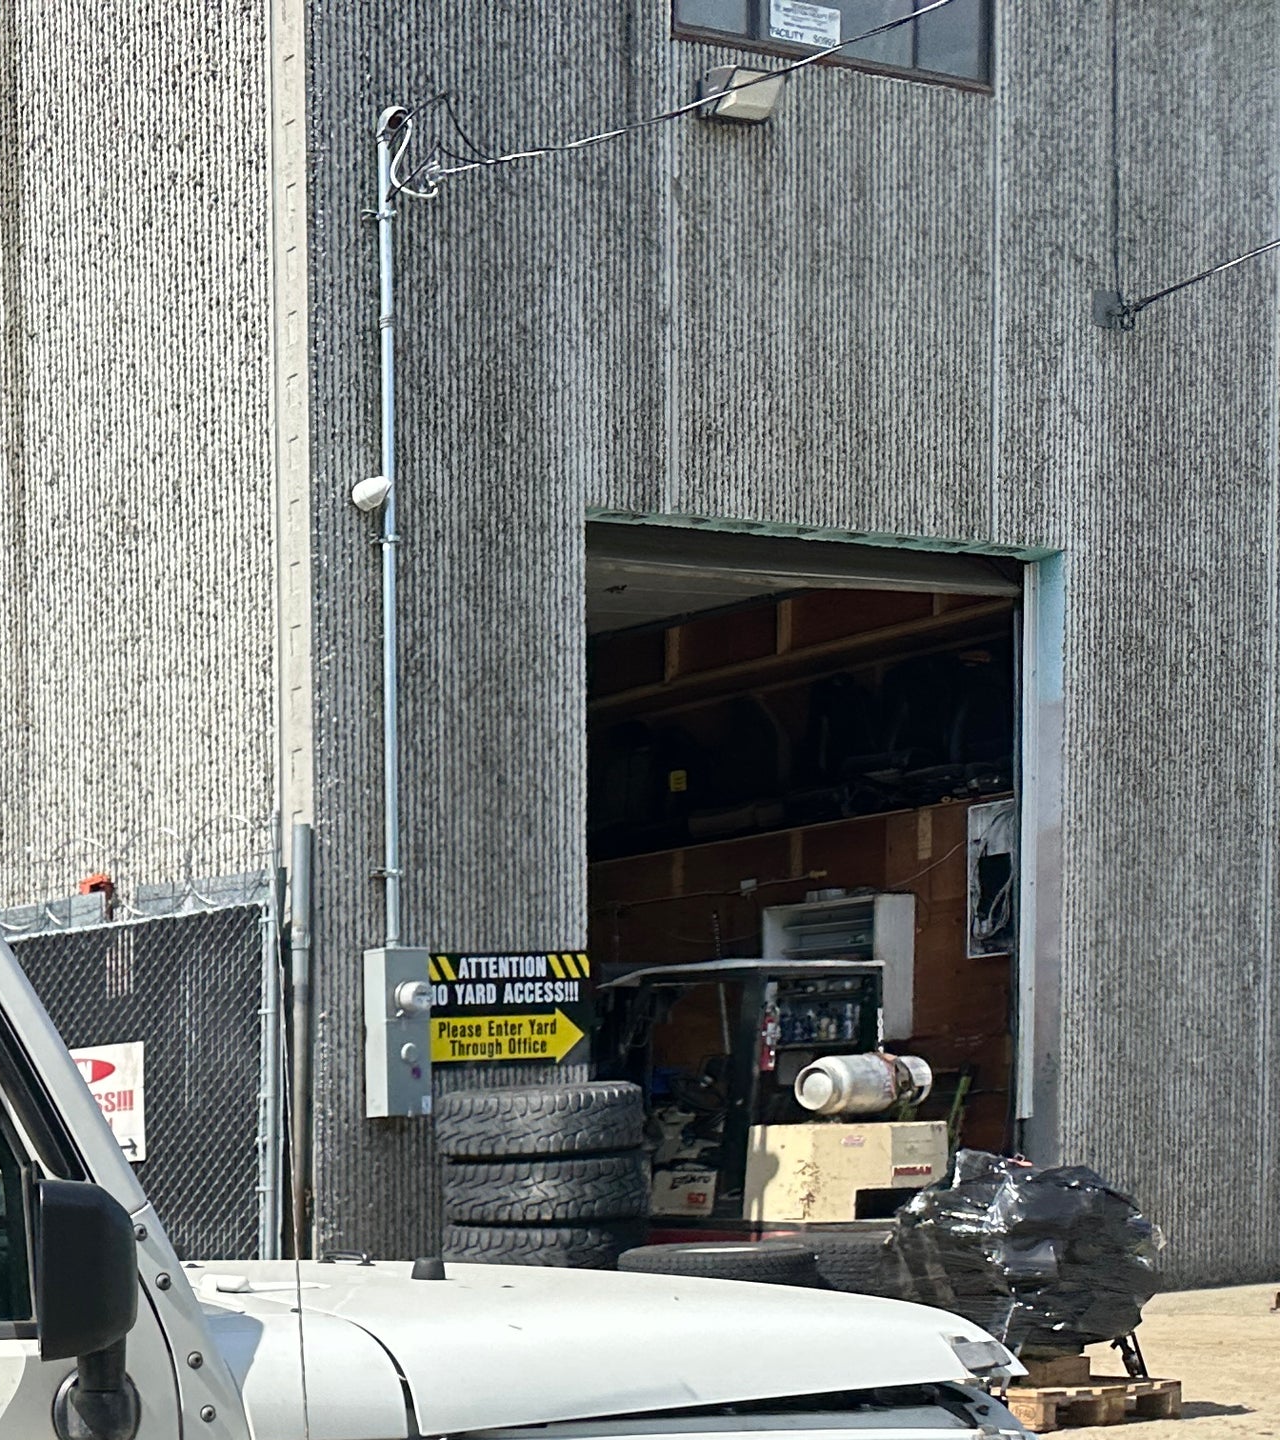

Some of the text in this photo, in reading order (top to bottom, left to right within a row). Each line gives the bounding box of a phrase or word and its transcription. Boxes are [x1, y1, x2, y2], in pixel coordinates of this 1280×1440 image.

[458, 956, 547, 979] ATTENTION
[455, 983, 497, 1005] YARD
[503, 981, 579, 1004] ACCESS!!!
[438, 1018, 557, 1039] Please Enter Yard
[450, 1038, 547, 1058] Through Office
